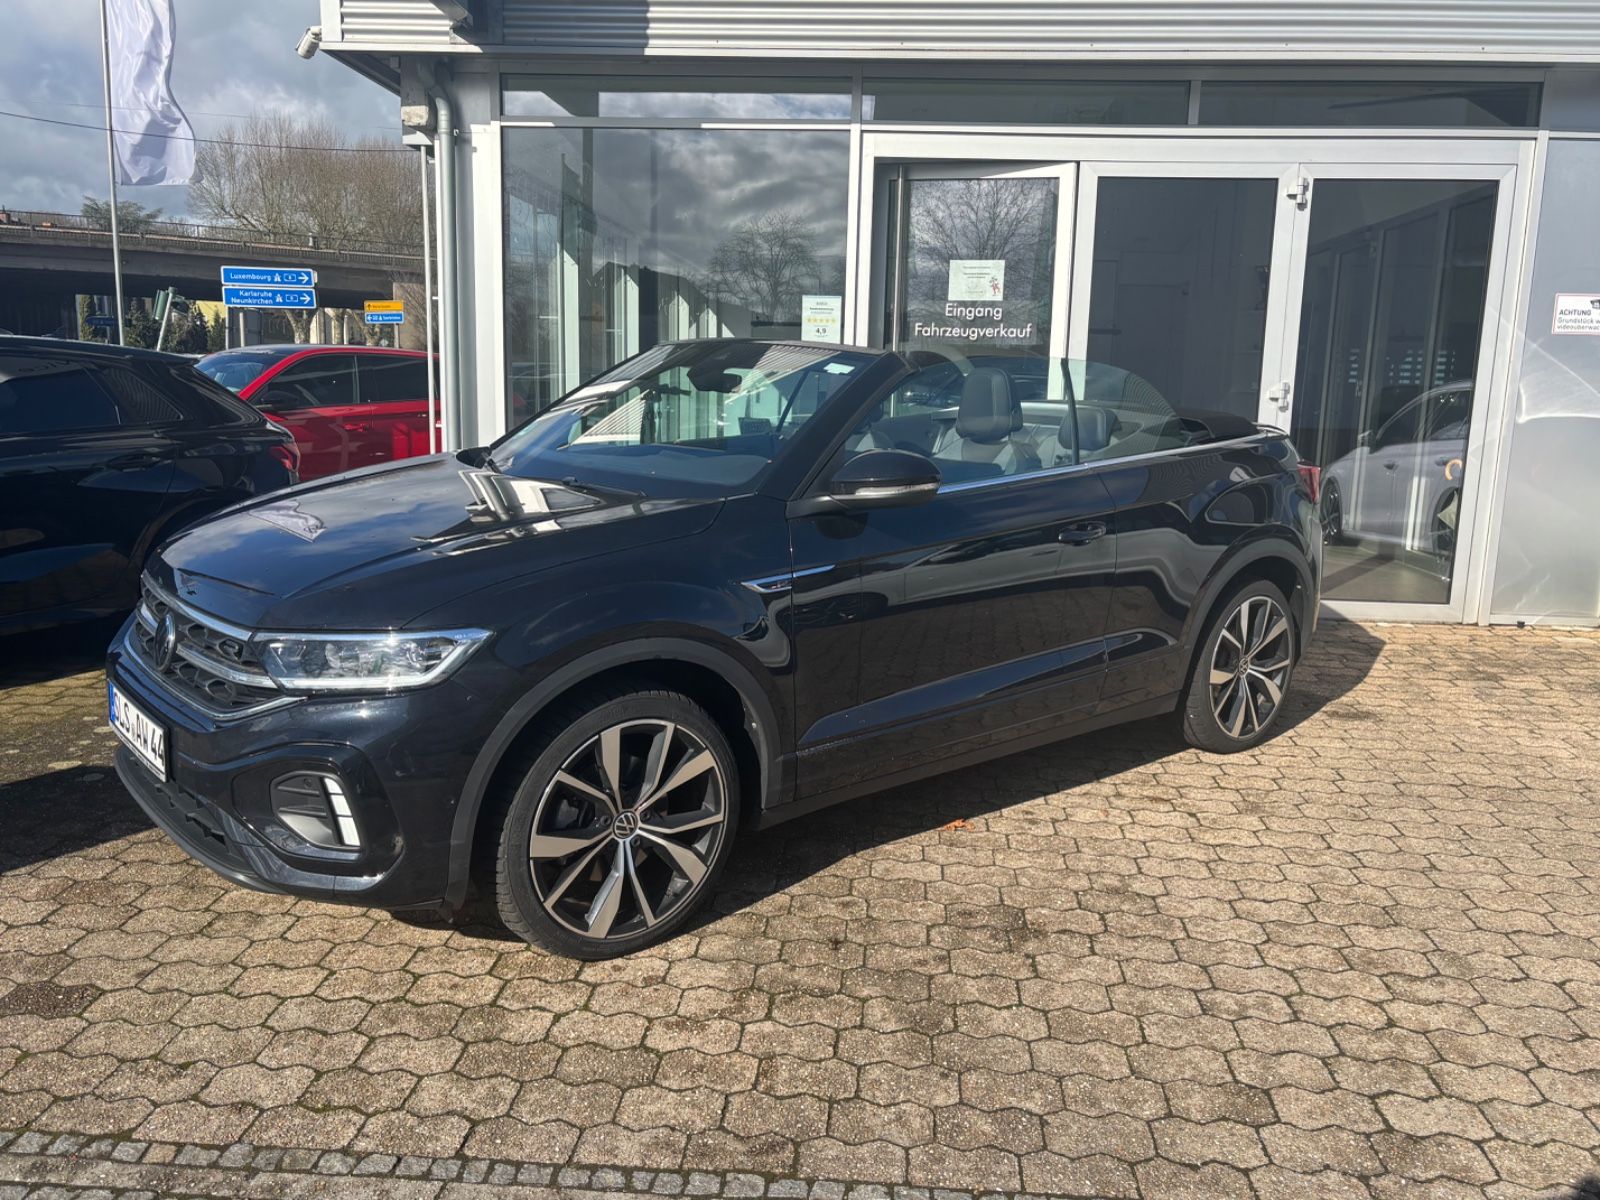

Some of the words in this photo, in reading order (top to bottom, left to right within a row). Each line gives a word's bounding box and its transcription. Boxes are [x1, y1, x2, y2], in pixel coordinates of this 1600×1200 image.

[230, 273, 271, 282] Luxembourg
[231, 297, 273, 305] Neunkirchen
[945, 303, 1003, 320] Eingang
[914, 322, 1033, 341] Fahrzeugverkauf
[113, 691, 131, 733] SLS
